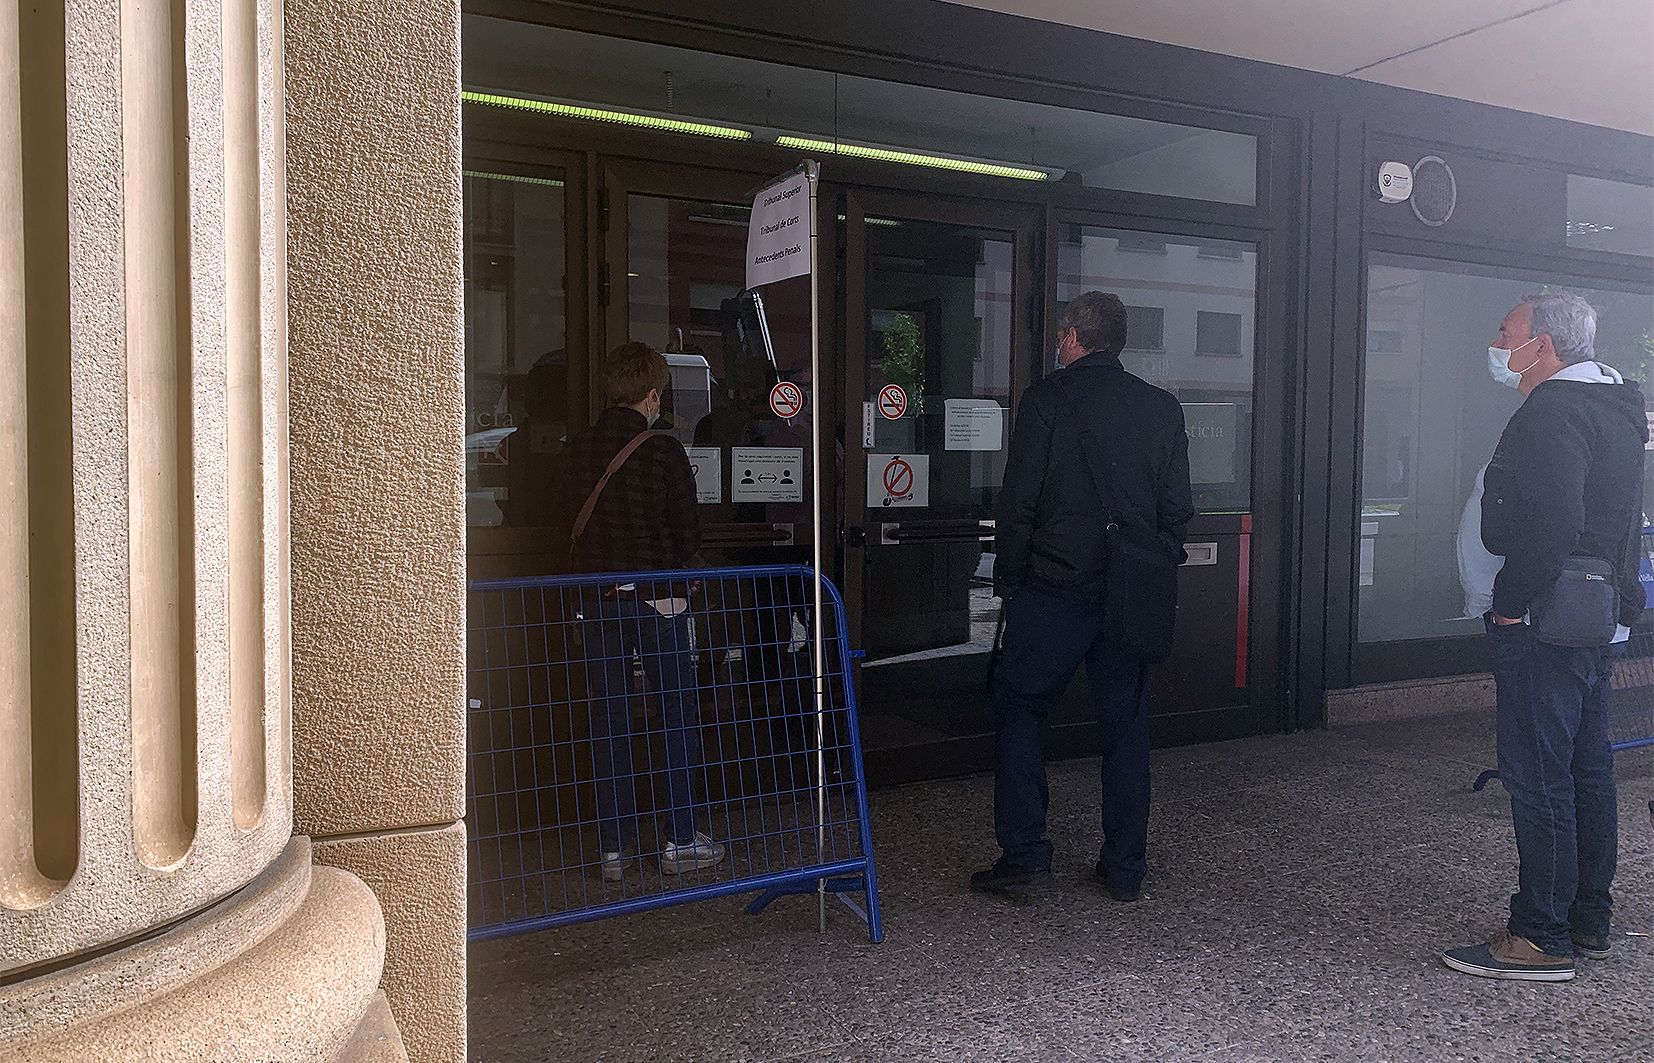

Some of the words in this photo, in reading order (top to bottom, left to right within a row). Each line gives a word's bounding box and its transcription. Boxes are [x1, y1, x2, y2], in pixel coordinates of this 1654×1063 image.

[763, 192, 783, 207] Tribunal
[782, 185, 801, 199] Superior
[760, 220, 780, 236] Tribunal
[780, 219, 787, 229] de
[787, 215, 800, 227] Corts
[754, 250, 785, 265] Antecedents
[784, 244, 801, 255] Penals
